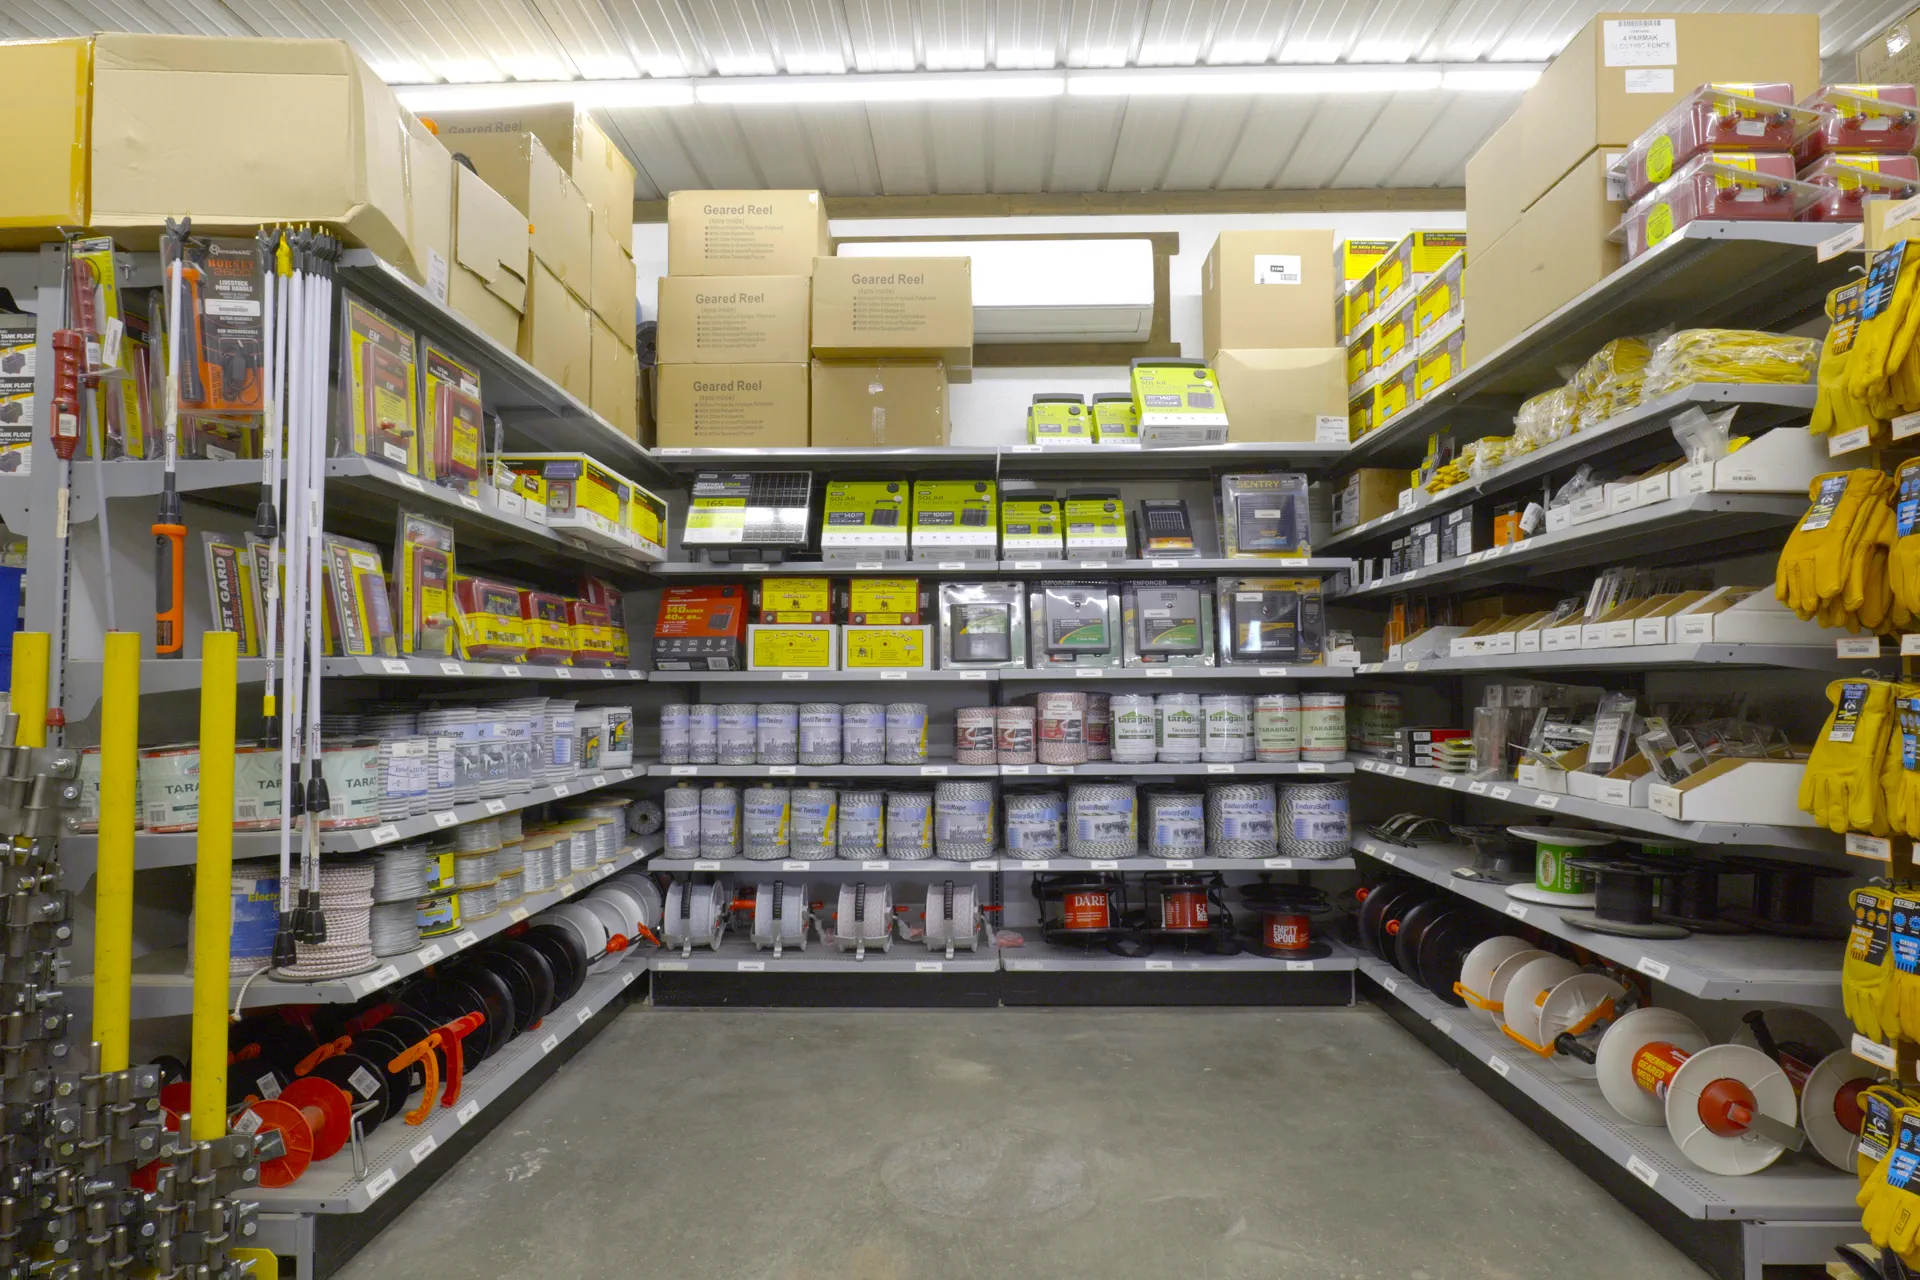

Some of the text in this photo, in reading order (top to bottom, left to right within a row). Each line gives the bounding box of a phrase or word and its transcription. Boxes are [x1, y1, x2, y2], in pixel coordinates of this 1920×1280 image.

[494, 119, 522, 132] Reel
[703, 204, 773, 215] Geared Reel
[851, 273, 924, 285] Geared Reel
[695, 293, 764, 304] Geared Reel
[693, 380, 762, 392] Geared Reel
[1235, 480, 1280, 489] SENTRY
[215, 557, 231, 602] GARD
[336, 557, 356, 638] GARD PET
[1295, 802, 1331, 810] EnduraSoft
[1157, 809, 1191, 817] EnduraSoft
[1074, 895, 1105, 906] DARE
[1273, 924, 1298, 935] EMPTY
[1273, 933, 1298, 944] SPOOL
[1640, 1051, 1677, 1074] PREMIUM
[1637, 1059, 1665, 1080] GEARED
[1636, 1067, 1655, 1085] MEGA
